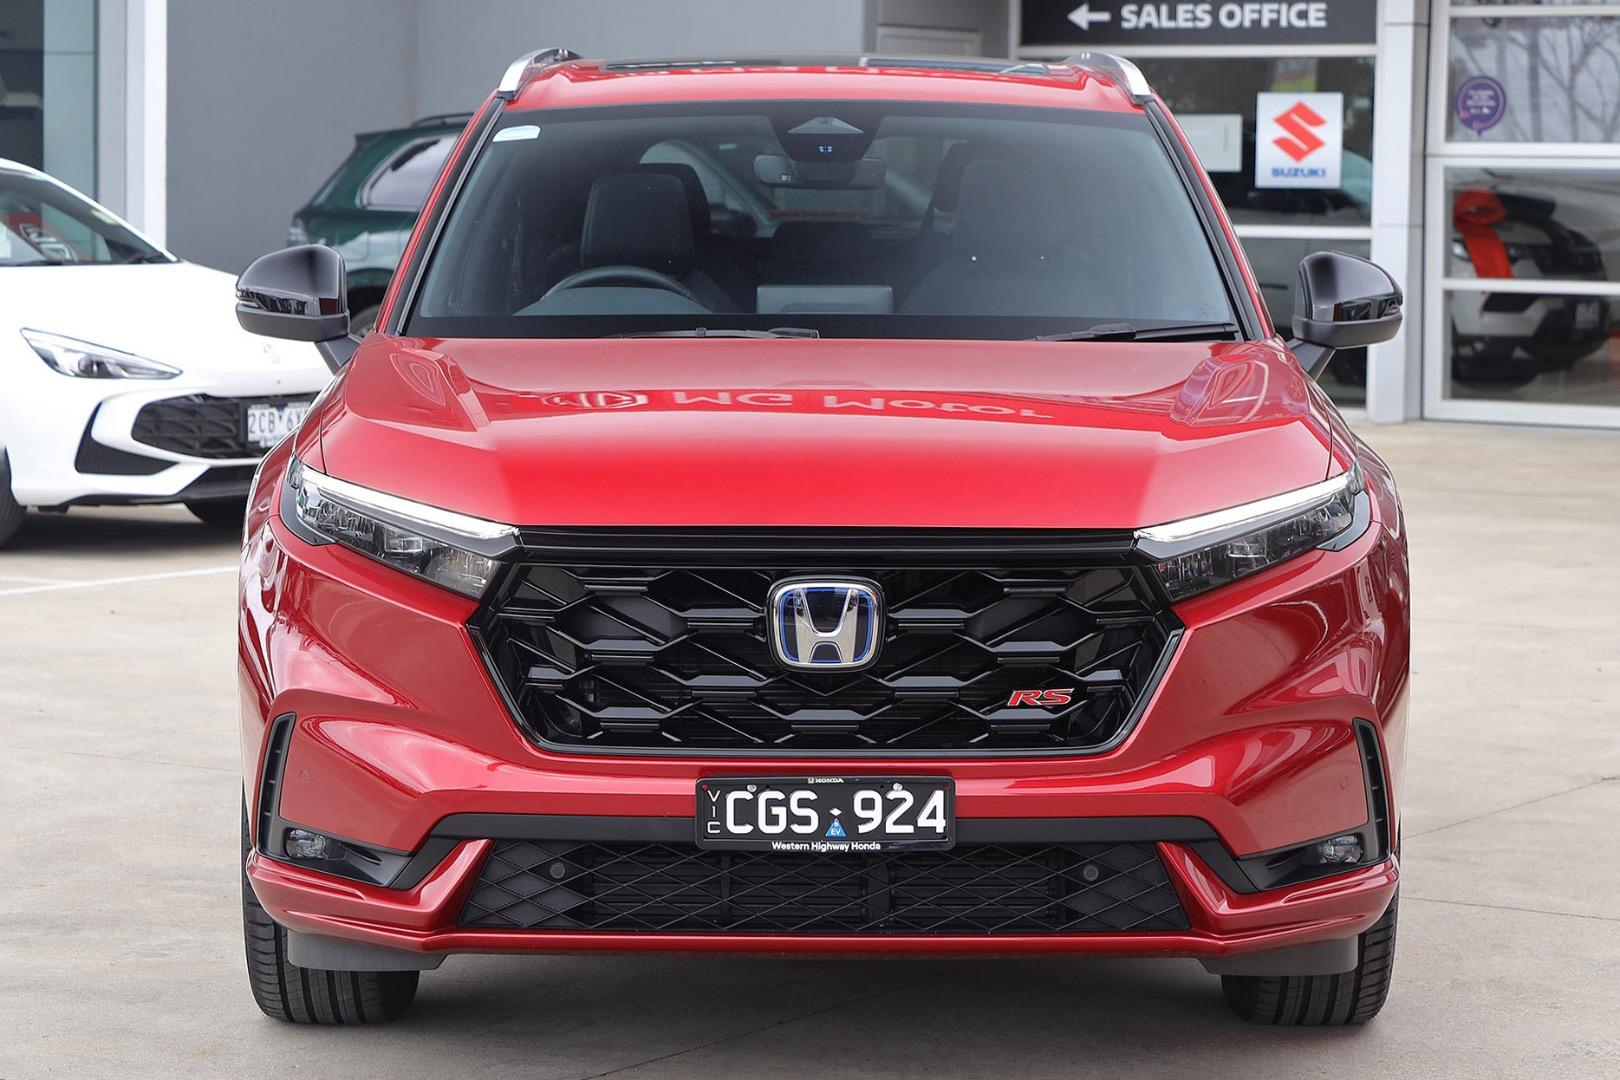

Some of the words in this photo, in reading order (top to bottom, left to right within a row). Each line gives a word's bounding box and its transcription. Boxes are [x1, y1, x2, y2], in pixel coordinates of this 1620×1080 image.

[1120, 3, 1213, 29] SALES
[1218, 3, 1327, 28] OFFICE
[1271, 167, 1327, 178] SUZUKI
[248, 412, 276, 433] 2CB
[1007, 688, 1074, 706] RS
[725, 790, 819, 834] CGS
[853, 789, 946, 834] 924
[830, 828, 841, 836] EV
[771, 841, 809, 850] Western
[811, 841, 849, 852] Highway
[851, 841, 881, 850] Honda
